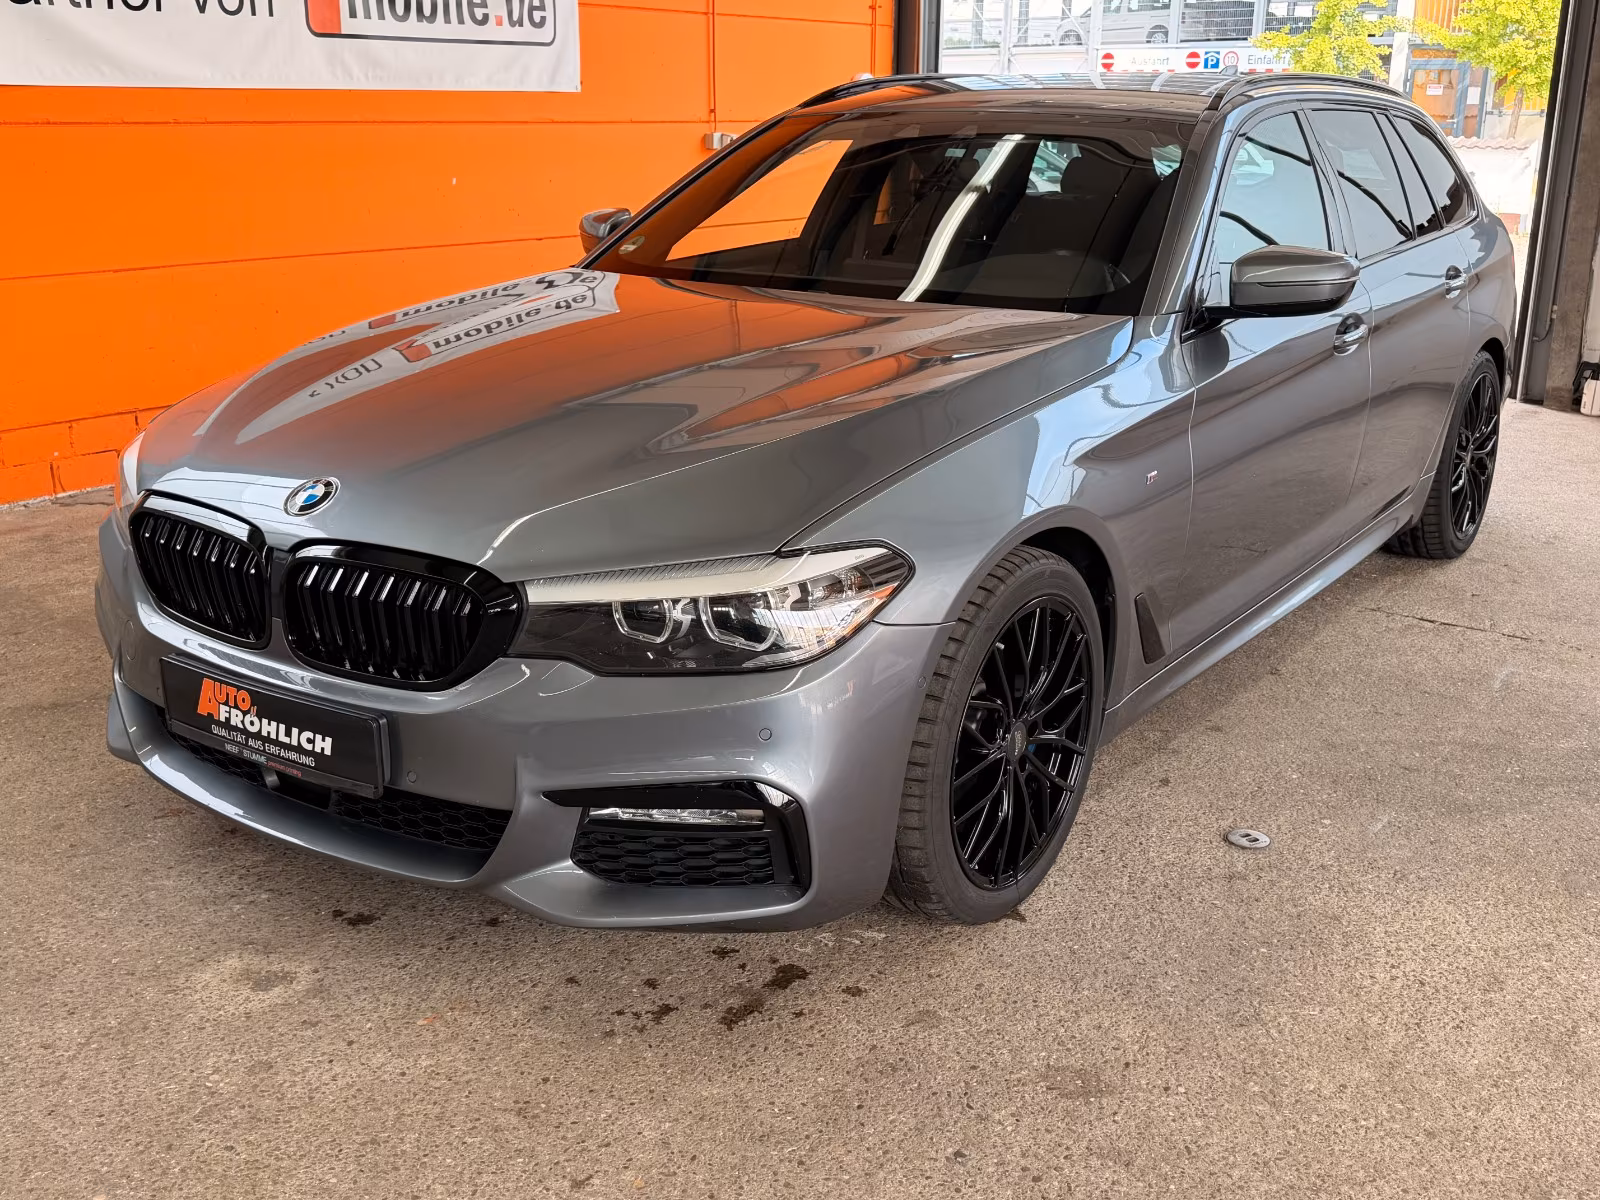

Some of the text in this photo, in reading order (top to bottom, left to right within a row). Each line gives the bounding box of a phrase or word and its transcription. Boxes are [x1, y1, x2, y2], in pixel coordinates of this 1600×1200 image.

[1227, 56, 1236, 65] 10
[197, 677, 252, 721] AUTO
[211, 724, 315, 767] QUALITÄT AUS ERFAHRUNG
[219, 704, 333, 756] FRÖHLICH
[243, 749, 267, 765] STUMME
